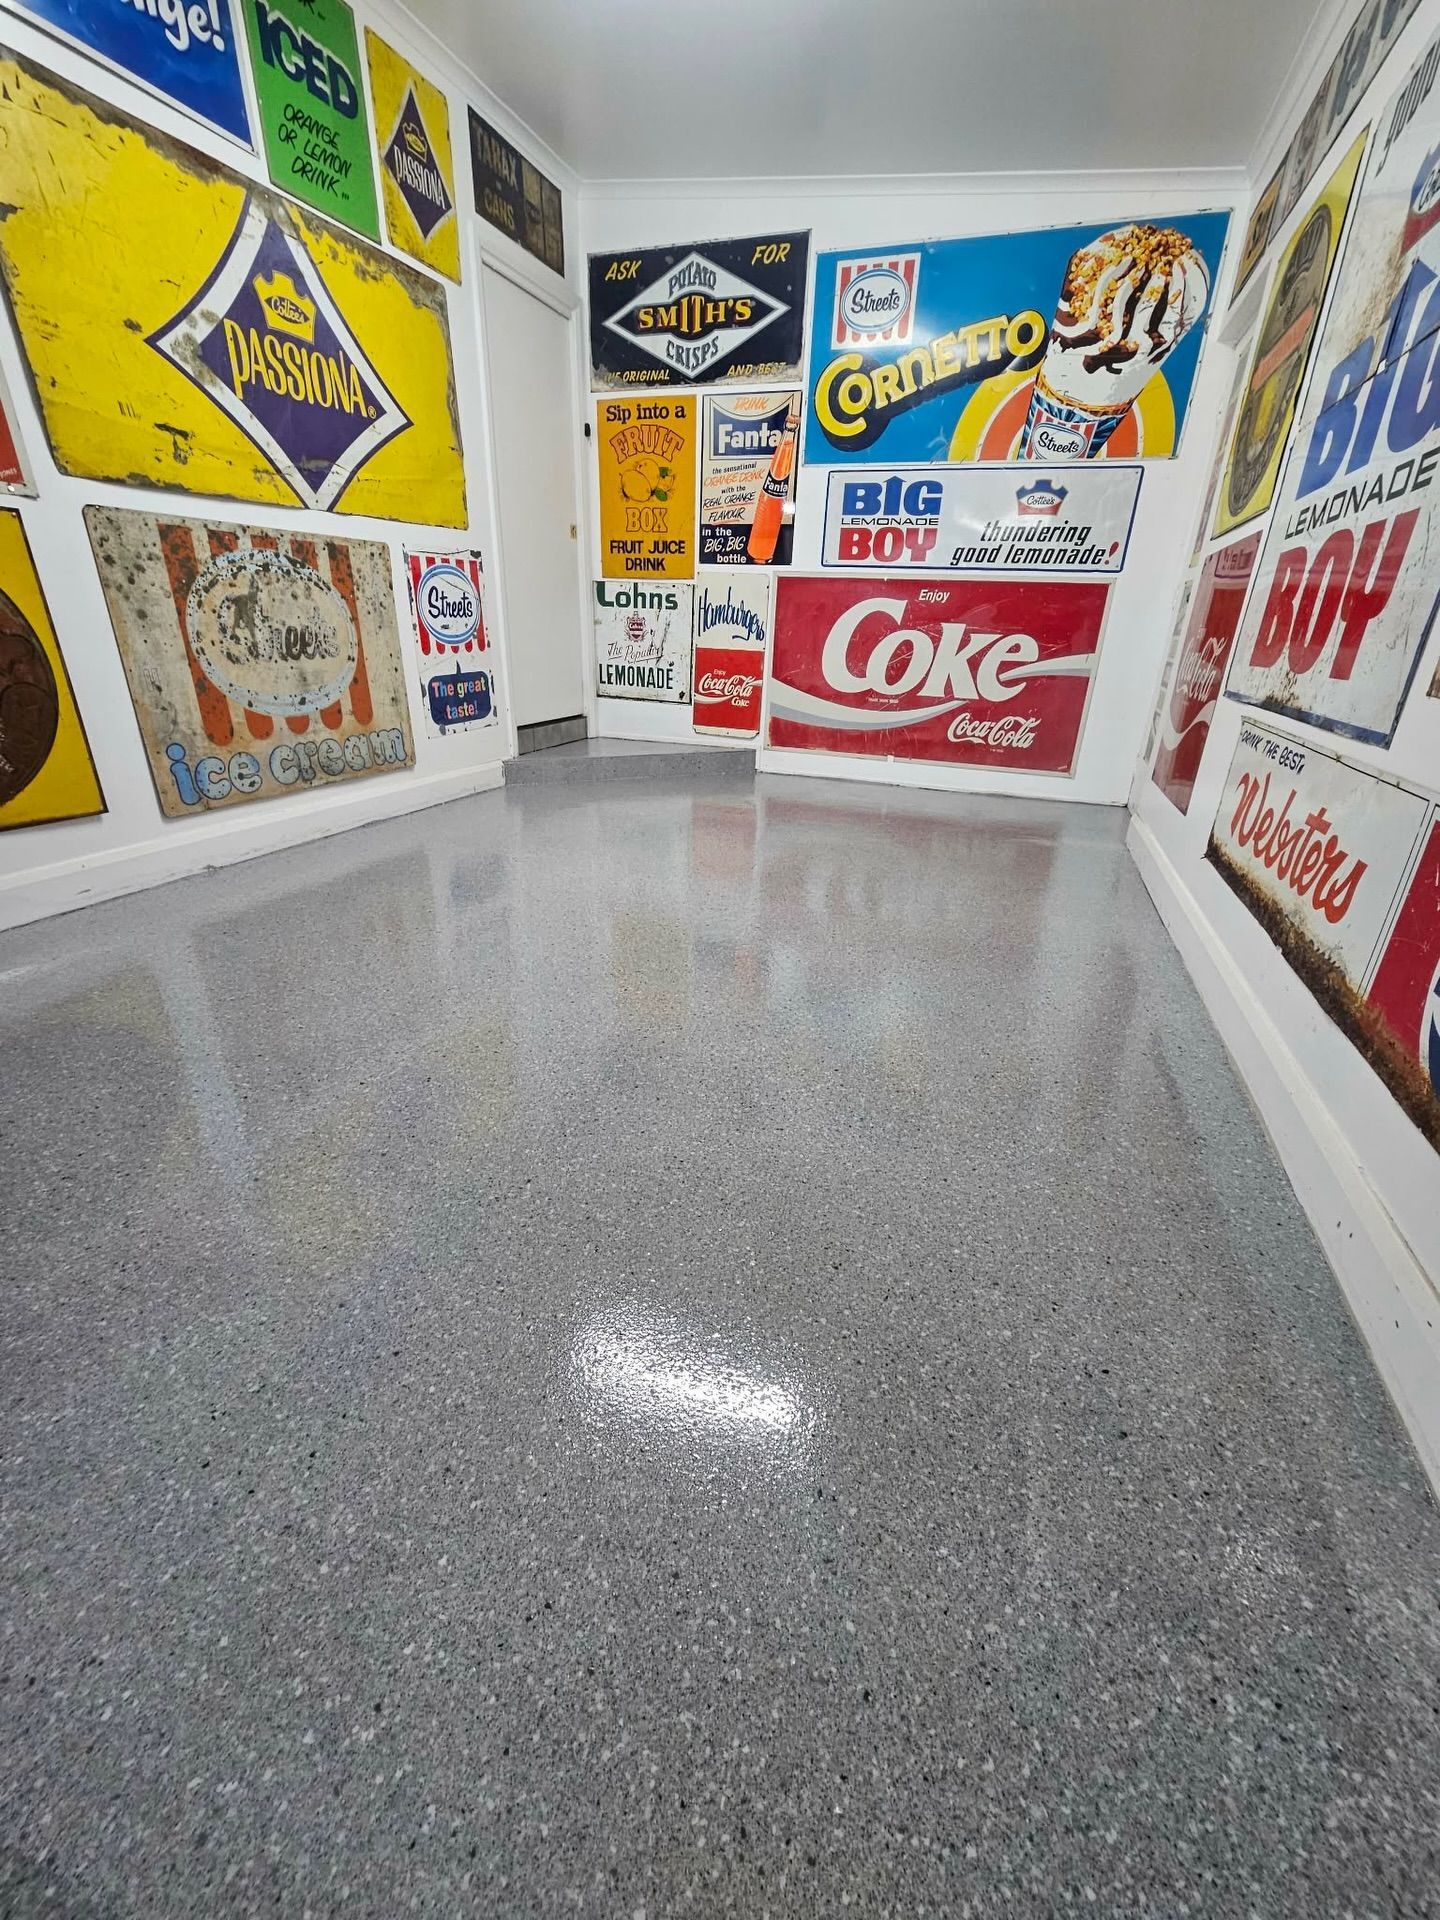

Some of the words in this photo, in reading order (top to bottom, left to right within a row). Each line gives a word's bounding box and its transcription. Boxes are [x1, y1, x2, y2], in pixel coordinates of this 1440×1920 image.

[255, 0, 358, 119] ICED
[284, 104, 340, 150] ORANGE
[278, 124, 297, 149] OR
[304, 141, 352, 178] LEMON
[394, 145, 446, 210] PASSIONA
[605, 260, 642, 281] ASK
[751, 243, 791, 266] FOR
[668, 261, 718, 298] POTATO
[851, 288, 900, 313] Streets
[638, 295, 752, 334] SMITH'S
[666, 336, 719, 372] CRISPS
[224, 318, 367, 418] PASSIONA
[622, 369, 670, 382] ORIGINAL
[727, 364, 753, 376] AND
[606, 405, 631, 424] Sip
[637, 403, 669, 420] into
[675, 405, 686, 418] a
[609, 424, 685, 464] FRUIT
[719, 422, 782, 454] Fanta
[1038, 429, 1079, 453] Streets
[712, 467, 722, 475] the
[724, 461, 757, 473] sensational
[721, 486, 735, 494] with
[764, 477, 788, 492] Fanta
[842, 475, 943, 516] BIG
[1285, 446, 1440, 540] LEMONADE
[703, 497, 722, 508] REAL
[724, 491, 756, 504] ORANGE
[626, 507, 668, 532] BOX
[708, 507, 746, 522] FLAVOUR
[841, 517, 939, 526] LEMONADE
[702, 528, 712, 536] in
[715, 527, 732, 536] the
[726, 536, 746, 552] BIG
[981, 520, 1092, 546] thundering
[610, 540, 643, 554] FRUIT
[648, 540, 685, 554] JUICE
[838, 527, 938, 563] BOY
[950, 544, 1002, 566] good
[625, 558, 666, 571] DRINK
[717, 554, 747, 563] bottle
[428, 585, 473, 619] Streets
[919, 589, 950, 603] Enjoy
[1249, 508, 1420, 680] BOY
[698, 587, 765, 642] Hamburgers
[822, 598, 1038, 701] Coke
[432, 681, 454, 698] The
[457, 677, 486, 698] great
[599, 664, 673, 690] LEMONADE
[446, 701, 478, 720] taste!
[1242, 730, 1263, 752] DRINK
[1263, 740, 1278, 760] THE
[166, 743, 263, 805] ice
[269, 727, 407, 785] cream
[1231, 771, 1369, 924] Websters
